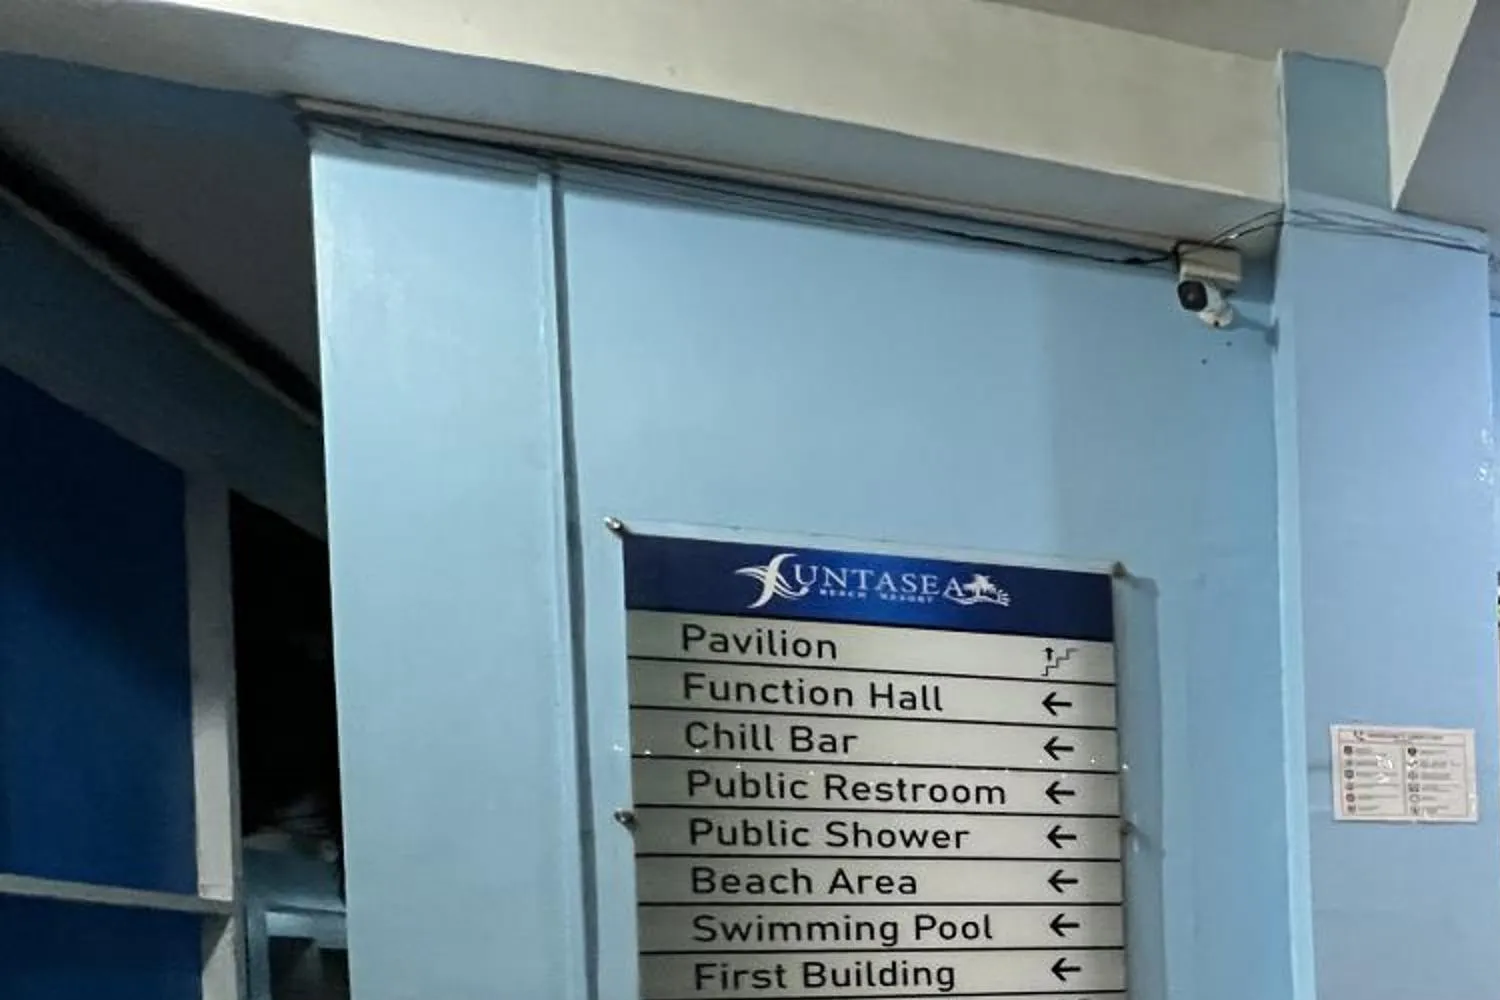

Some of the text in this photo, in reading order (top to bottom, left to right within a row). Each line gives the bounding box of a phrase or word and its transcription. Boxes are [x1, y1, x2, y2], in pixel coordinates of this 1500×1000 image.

[682, 624, 837, 660] Pavilion
[683, 673, 943, 712] Function Hall
[685, 721, 858, 754] Chill Bar
[687, 769, 1006, 805] Public Restroom
[689, 819, 971, 850] Public Shower
[691, 866, 918, 896] Beach Area
[693, 914, 993, 947] Swimming Pool
[695, 960, 956, 992] First Building
